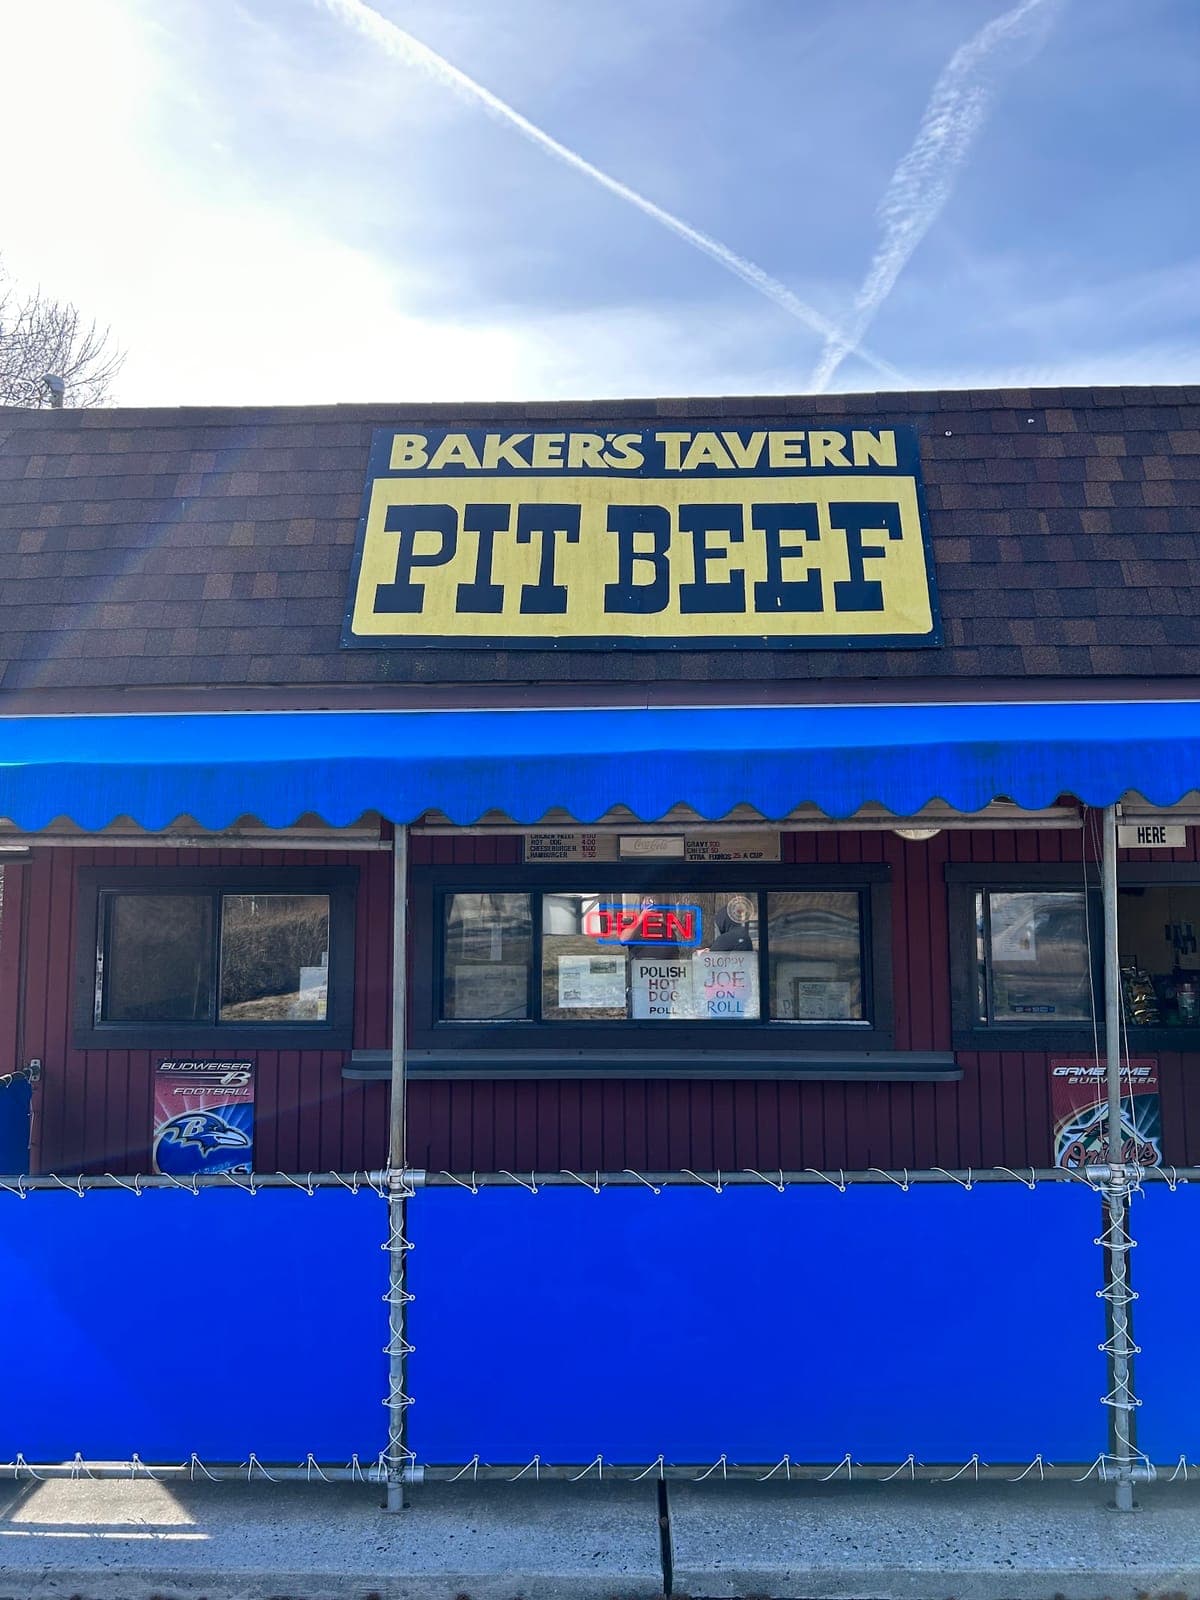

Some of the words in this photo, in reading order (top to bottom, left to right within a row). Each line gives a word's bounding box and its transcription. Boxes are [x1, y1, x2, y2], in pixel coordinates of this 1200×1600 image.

[390, 432, 645, 471] BAKER'S
[655, 430, 898, 471] TAVERN
[372, 503, 582, 614] PIT
[603, 501, 903, 614] BEEF
[1137, 826, 1167, 844] HERE
[586, 910, 693, 939] OPEN
[703, 956, 745, 968] SLOPPY
[639, 966, 687, 978] POLISH
[648, 978, 679, 990] HOT
[703, 971, 745, 988] JOE
[648, 990, 680, 1002] DOG
[716, 990, 736, 999] ON
[707, 1000, 745, 1014] ROLL
[160, 1062, 252, 1071] BUDWEISER
[173, 1087, 251, 1096] FOOTBALL
